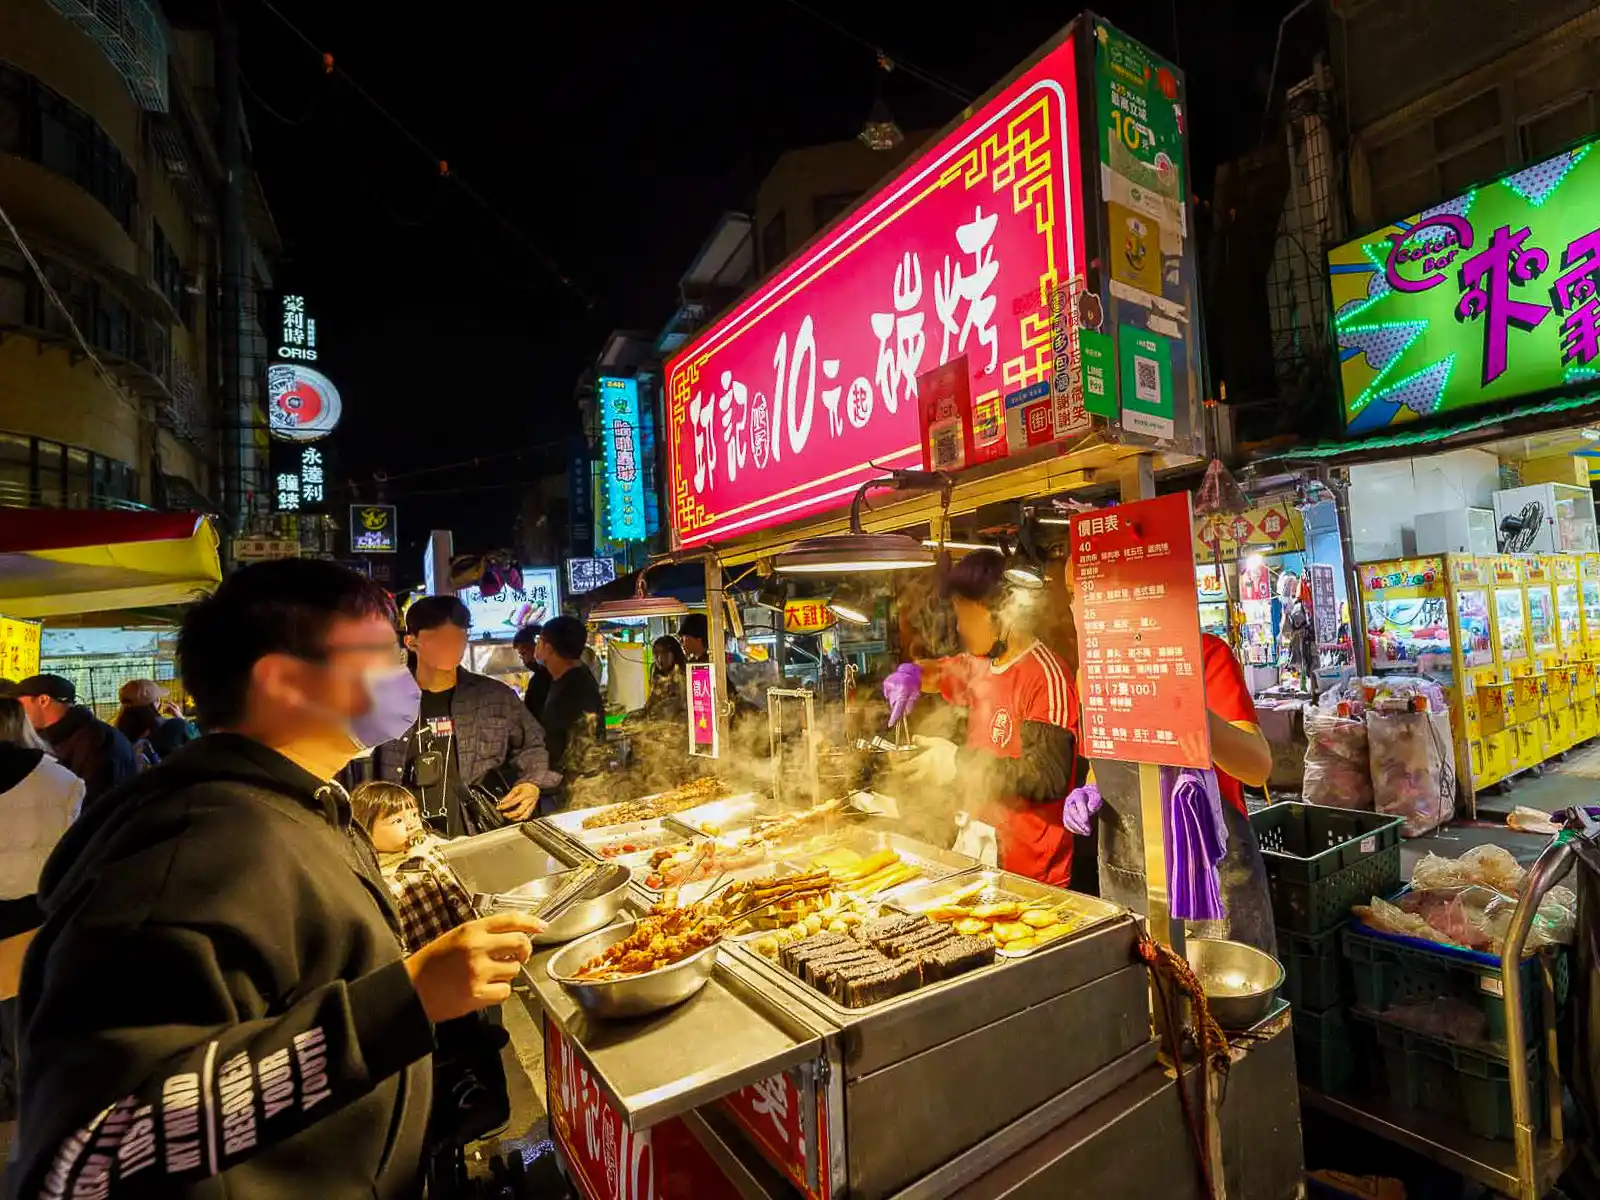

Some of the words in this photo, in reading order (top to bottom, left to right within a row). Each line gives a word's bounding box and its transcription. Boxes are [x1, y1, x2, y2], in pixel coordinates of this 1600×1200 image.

[278, 347, 317, 360] ORIS
[302, 447, 323, 501] 永達利
[1078, 514, 1119, 537] 價目表
[1079, 542, 1091, 552] 40
[1081, 581, 1094, 592] 30
[1086, 638, 1099, 648] 20
[258, 1046, 295, 1120] YOUR
[294, 1025, 332, 1112] YOUTH
[162, 1072, 200, 1138] MIND
[218, 1050, 258, 1156] RECOVER
[165, 1137, 201, 1174] MY
